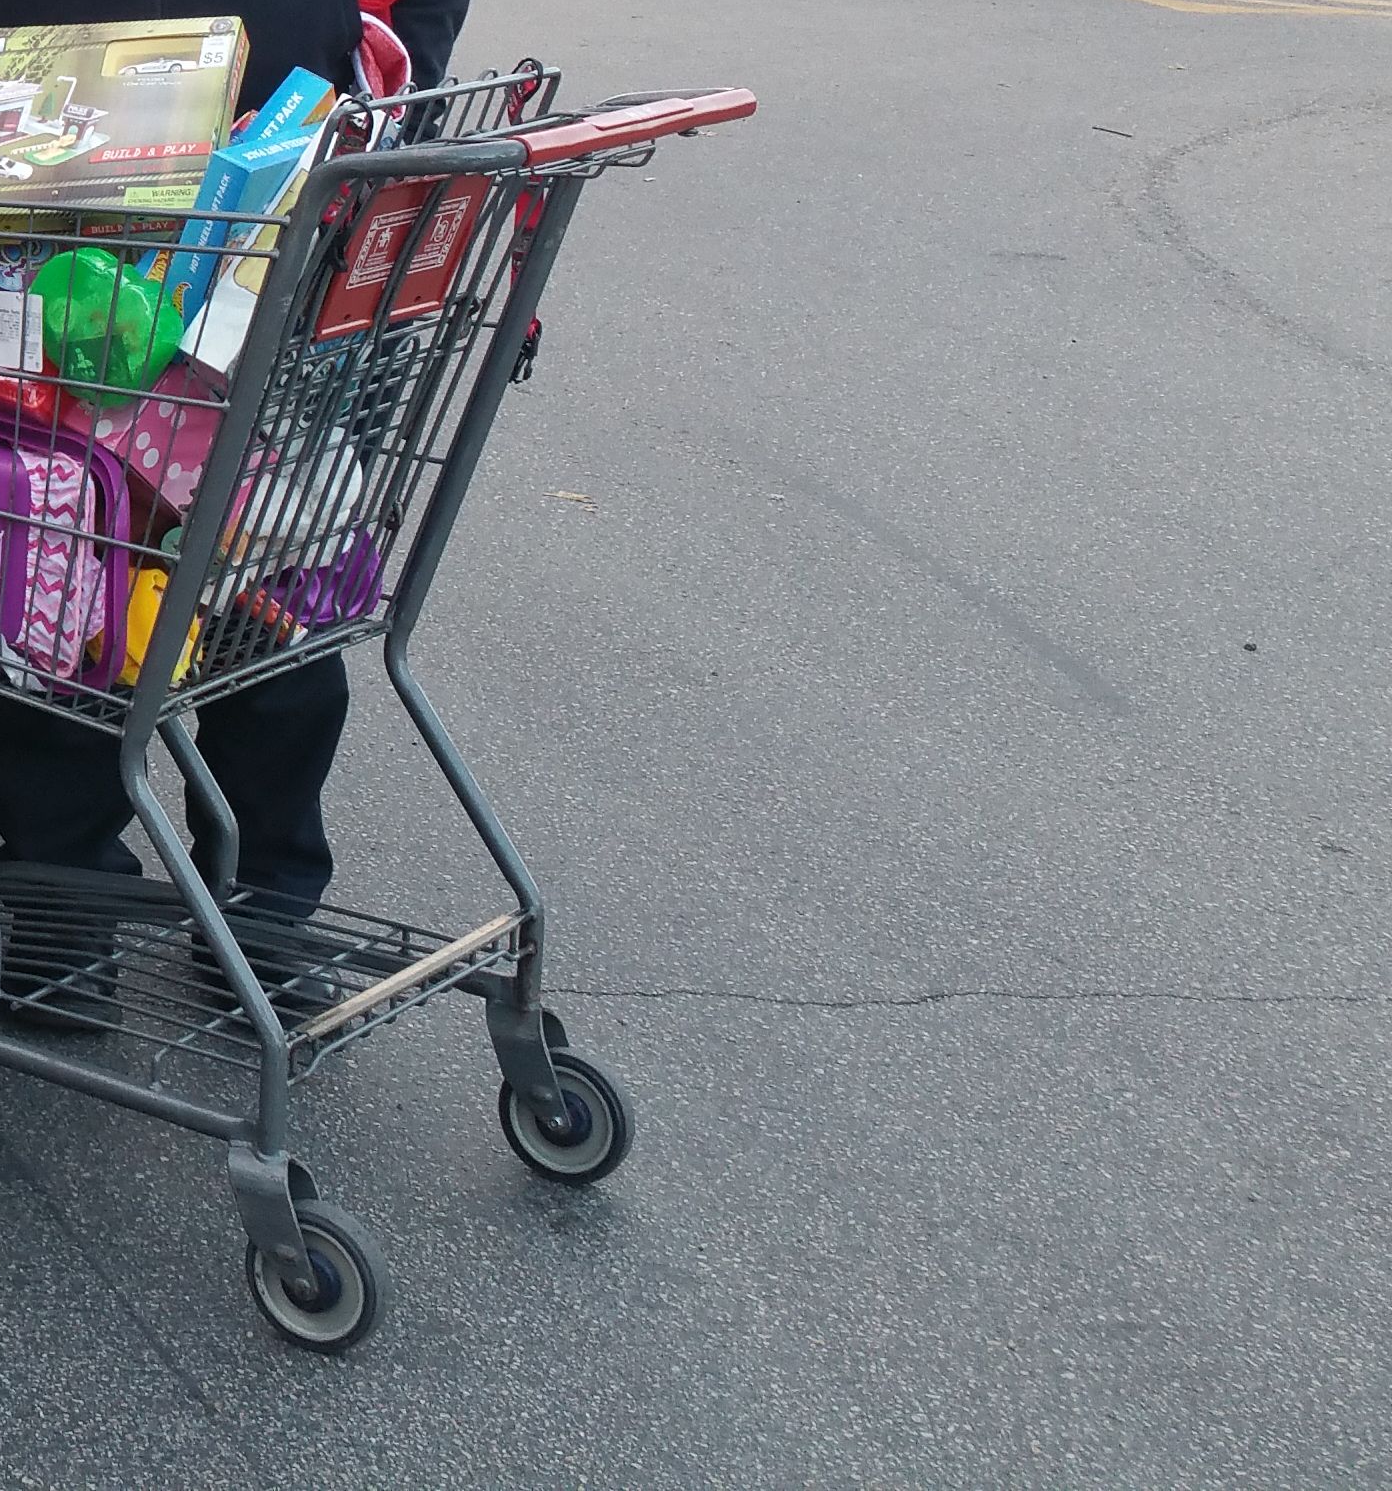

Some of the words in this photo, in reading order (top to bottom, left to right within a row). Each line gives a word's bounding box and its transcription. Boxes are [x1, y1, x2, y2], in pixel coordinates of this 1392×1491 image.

[202, 51, 224, 65] $5
[276, 91, 305, 126] PACK
[101, 148, 142, 160] BUILD
[147, 147, 156, 157] &
[162, 144, 197, 155] PLAY
[90, 224, 124, 235] BUILD
[142, 221, 169, 231] PLAY
[189, 253, 201, 274] HOT
[218, 173, 231, 200] PACK
